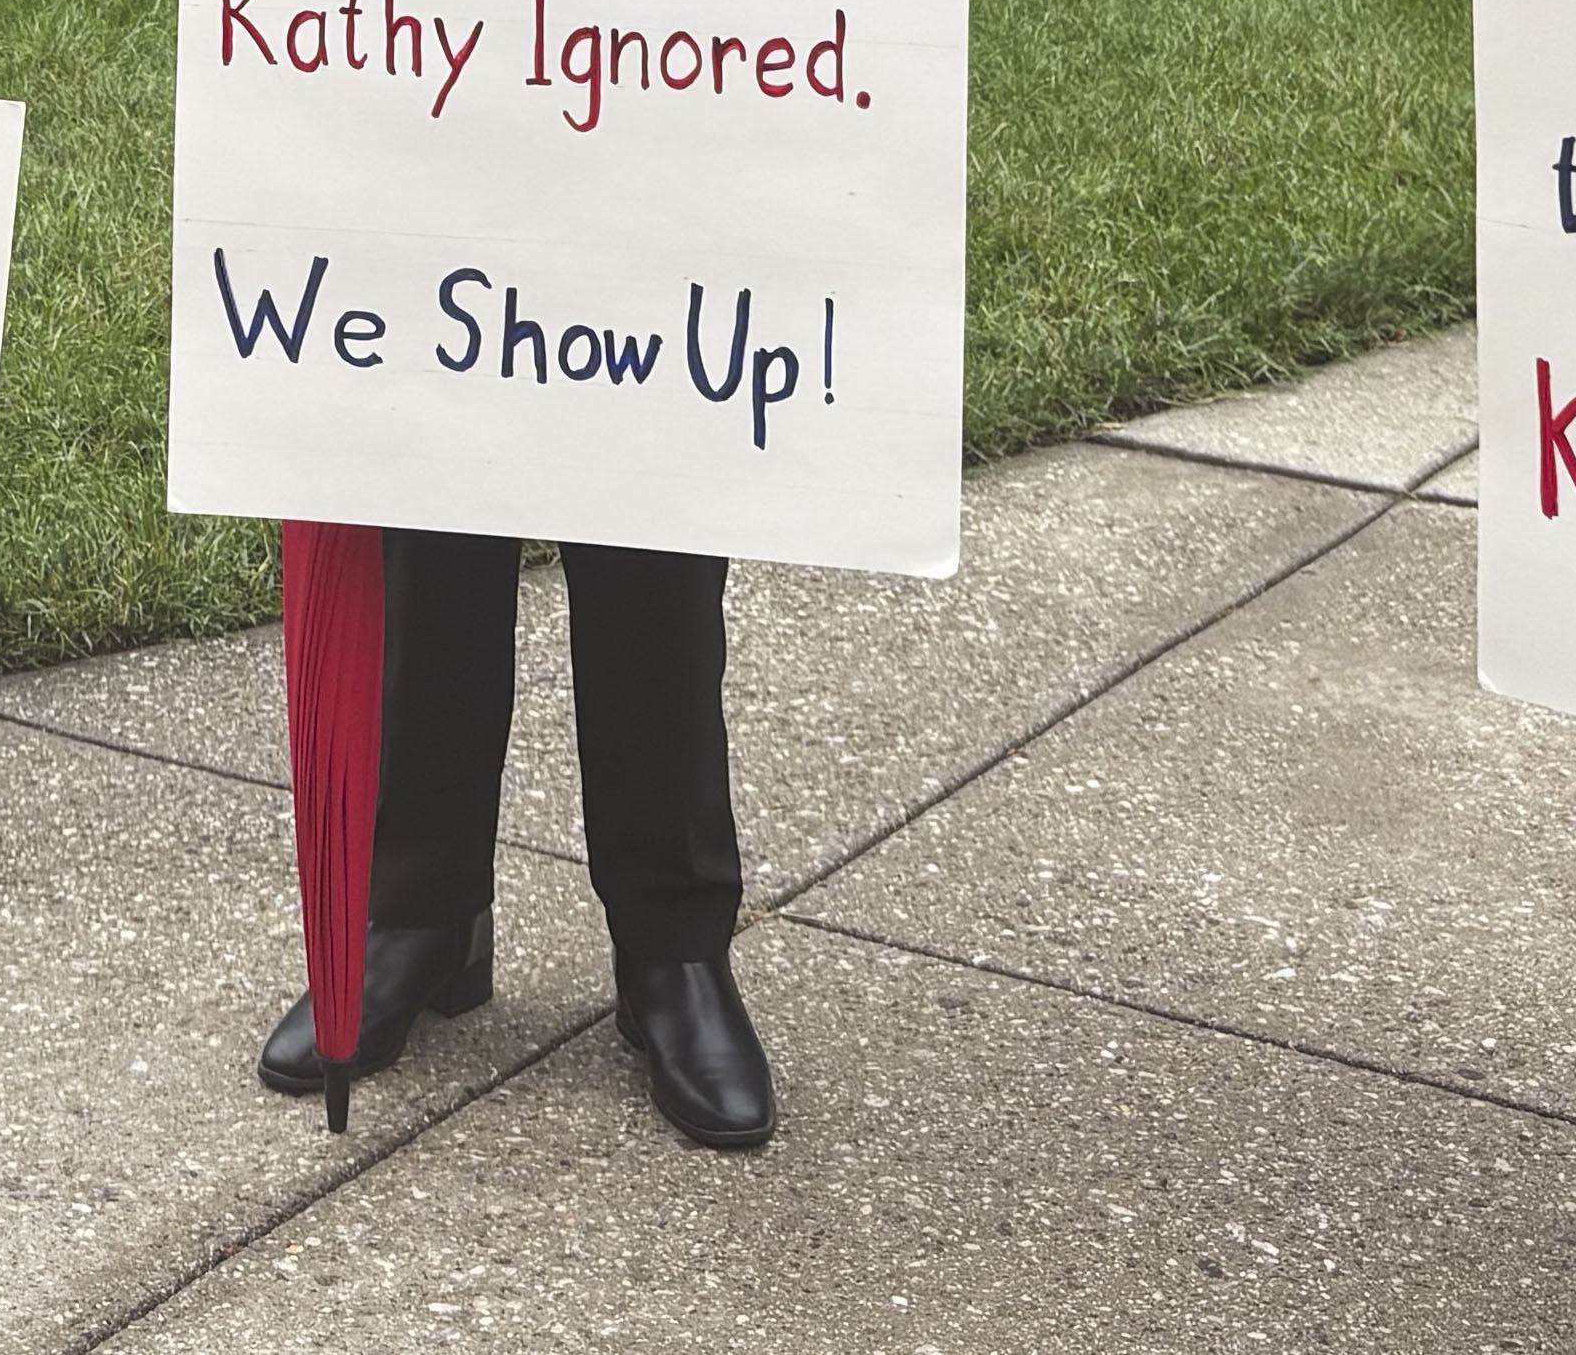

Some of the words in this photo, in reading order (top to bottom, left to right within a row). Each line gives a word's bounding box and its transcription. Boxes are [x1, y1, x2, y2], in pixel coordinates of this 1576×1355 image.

[214, 248, 385, 367] We
[436, 268, 662, 385] Show
[687, 283, 834, 450] Up!
